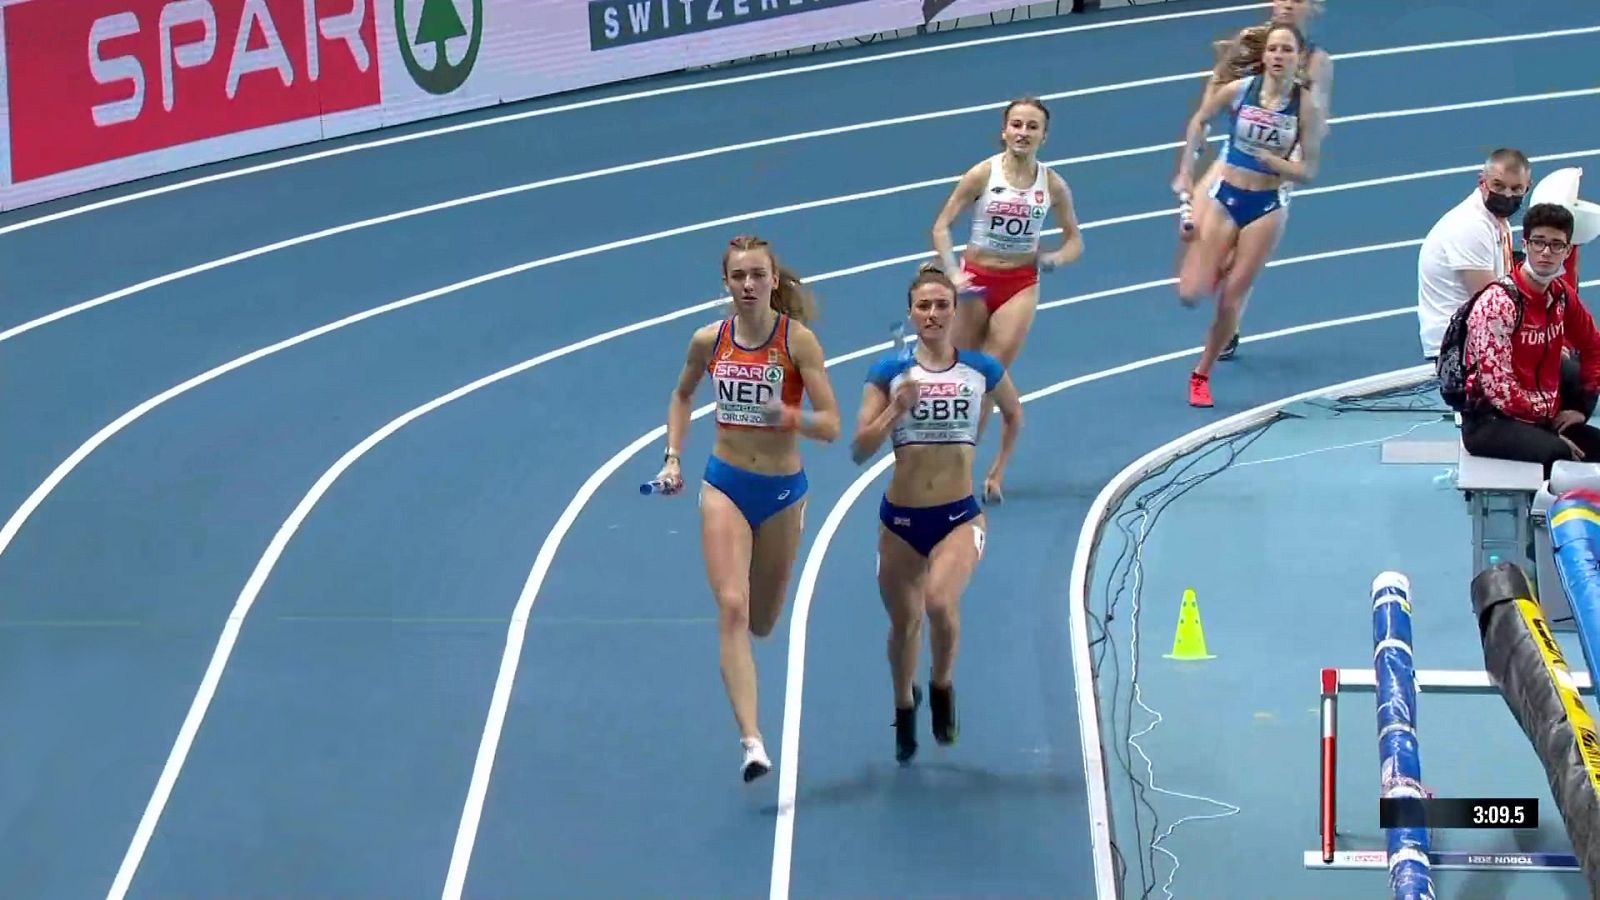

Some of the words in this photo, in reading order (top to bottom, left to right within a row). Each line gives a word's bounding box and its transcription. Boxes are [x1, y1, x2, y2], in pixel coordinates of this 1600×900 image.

[87, 0, 371, 128] SPAR
[1247, 123, 1281, 145] ITA
[990, 216, 1034, 236] POL
[716, 364, 763, 380] SPAR
[719, 380, 774, 405] NED
[919, 384, 956, 398] PAR
[911, 399, 970, 420] GBR
[1494, 856, 1533, 865] TORUN
